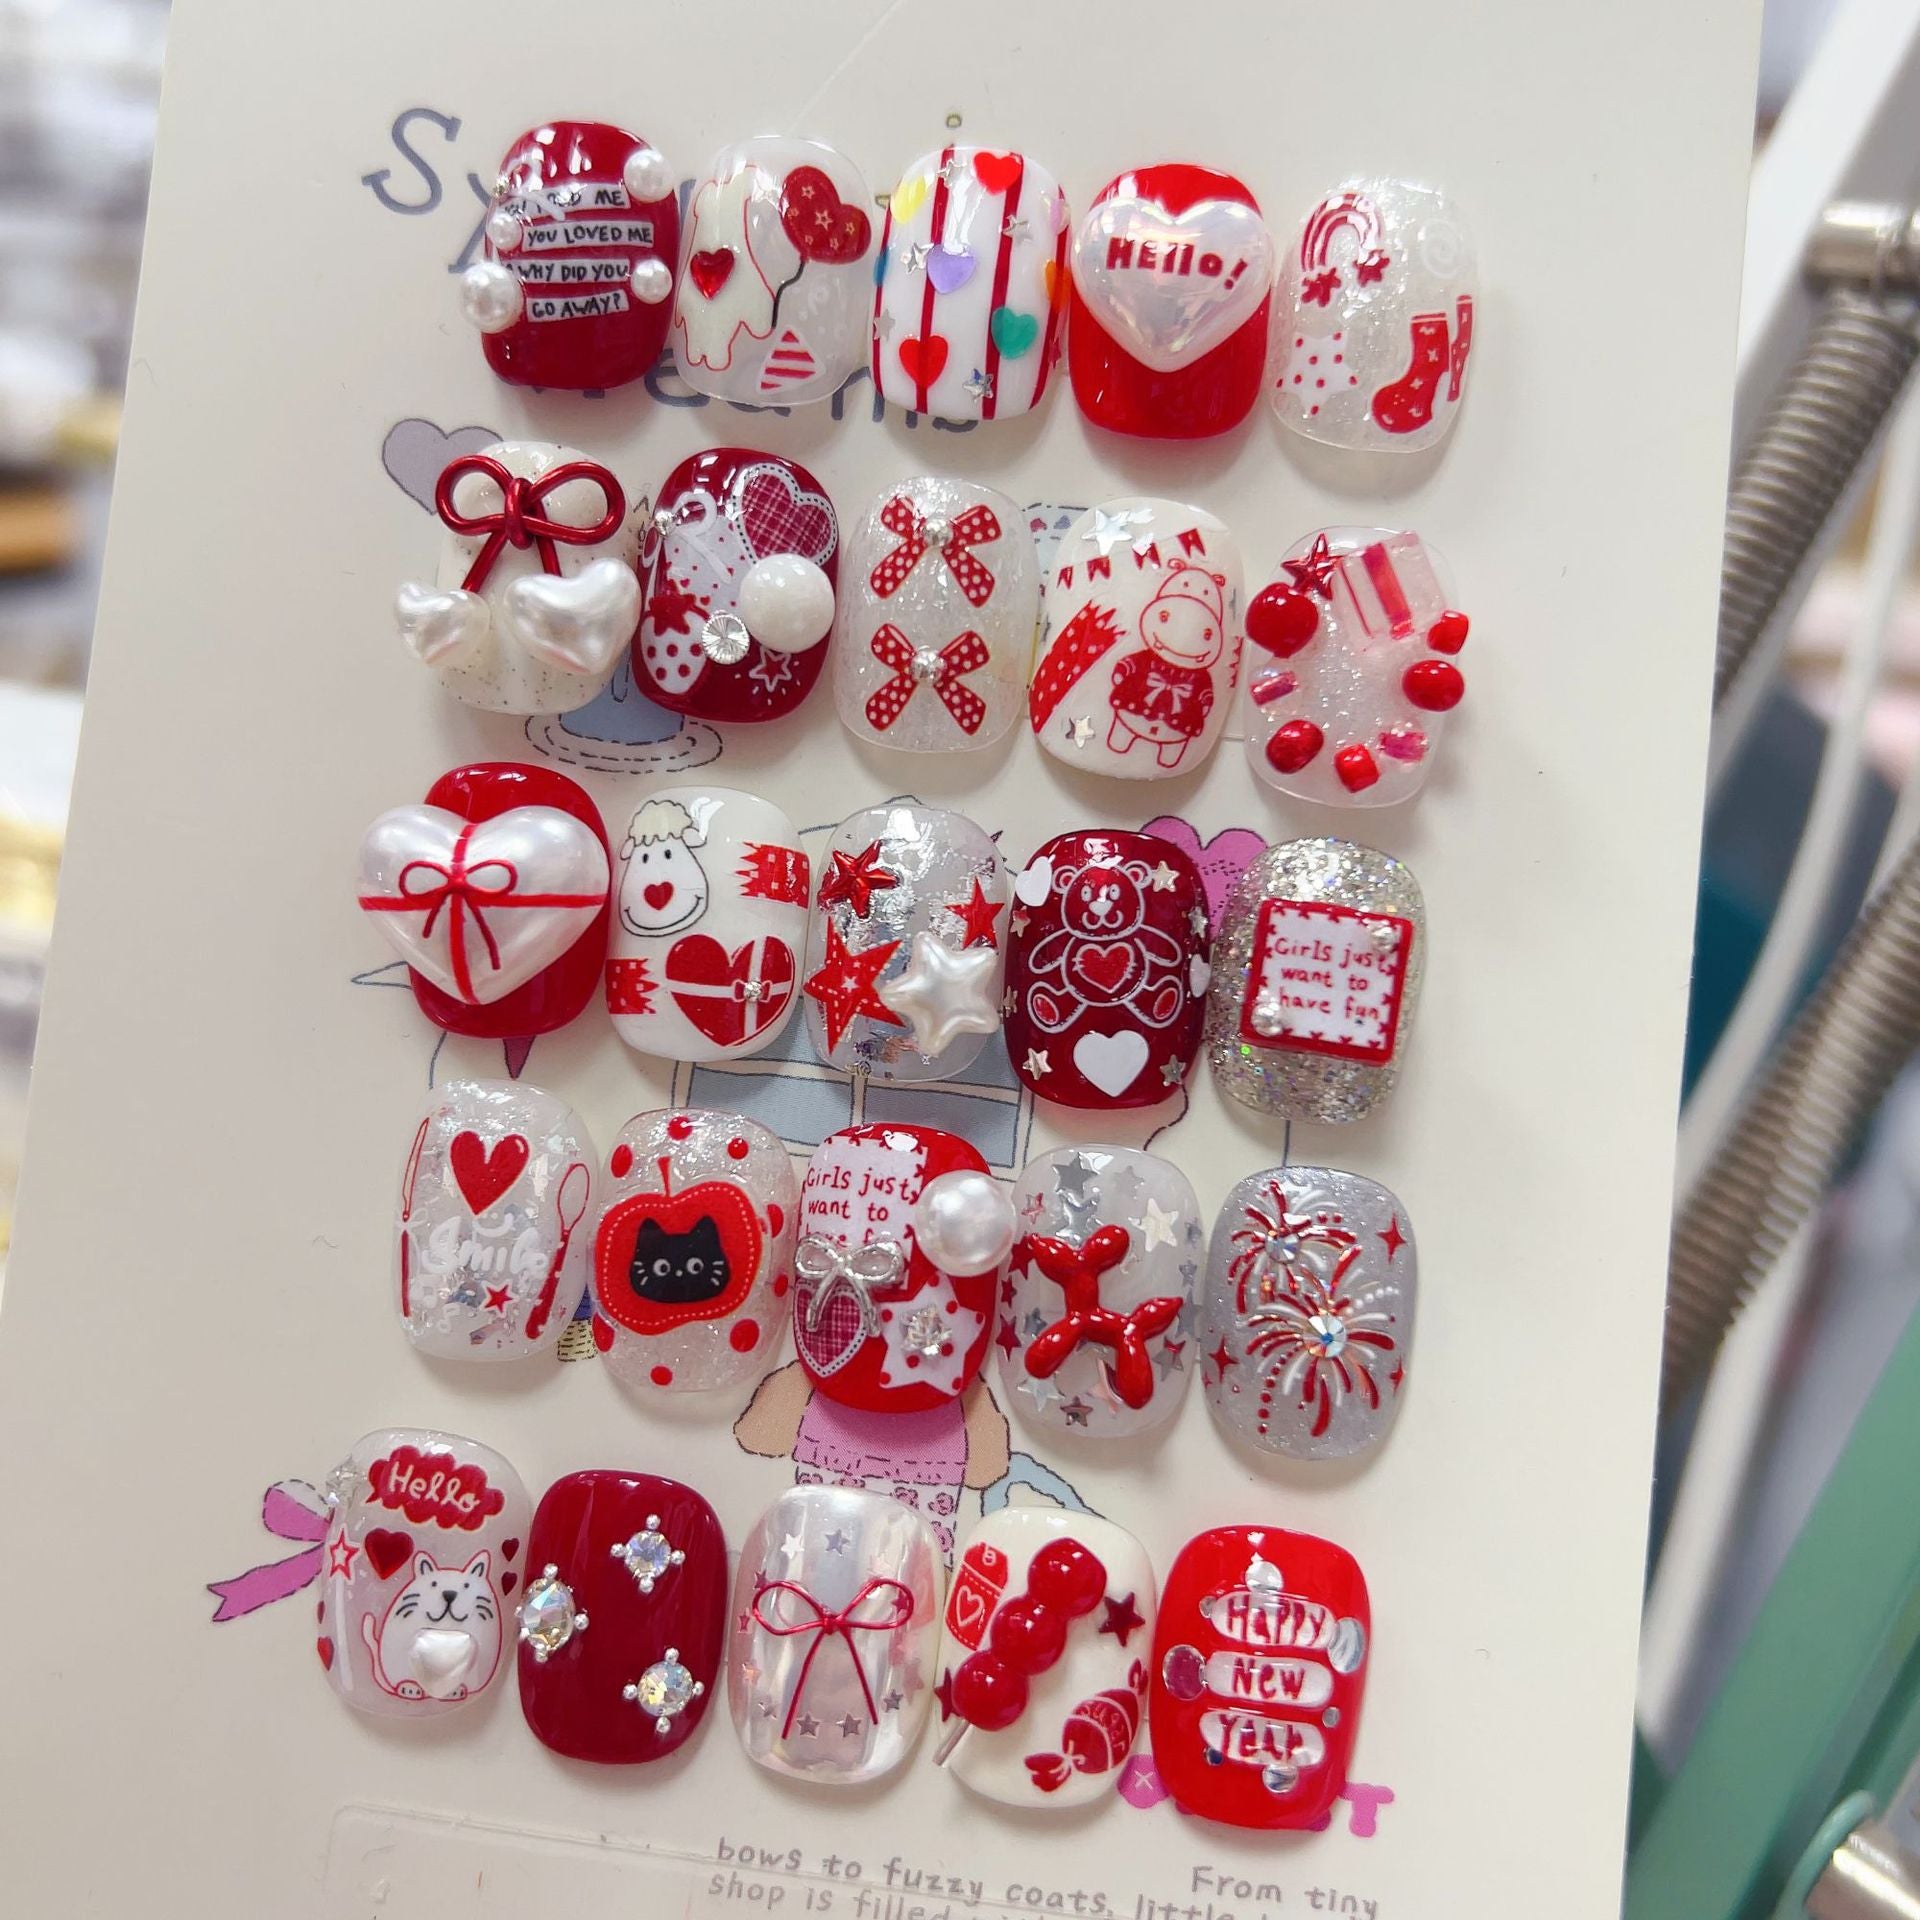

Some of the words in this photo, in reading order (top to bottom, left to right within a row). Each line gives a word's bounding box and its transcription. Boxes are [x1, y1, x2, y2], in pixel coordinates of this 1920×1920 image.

[595, 190, 625, 206] ME
[528, 230, 557, 246] YOU
[564, 225, 622, 244] LOVED
[628, 226, 653, 243] ME
[517, 263, 555, 282] WHY
[561, 265, 588, 281] DID
[591, 263, 628, 281] YOU
[532, 302, 555, 317] GO
[560, 293, 620, 317] AWAY?
[1274, 937, 1332, 961] Girls
[1281, 967, 1334, 987] want
[1349, 974, 1368, 991] to
[1279, 988, 1331, 1014] have
[1345, 997, 1380, 1020] fun
[806, 1165, 851, 1190] Girls
[858, 1167, 910, 1201] just
[807, 1199, 851, 1218] want
[868, 1203, 889, 1221] to
[388, 1461, 480, 1513] Hello
[717, 1836, 803, 1871] bows
[823, 1854, 862, 1880] to
[883, 1857, 984, 1907] fuzzy
[708, 1871, 786, 1911] shop
[806, 1887, 833, 1912] is
[1191, 1866, 1283, 1903] From
[1304, 1886, 1378, 1920] tiny
